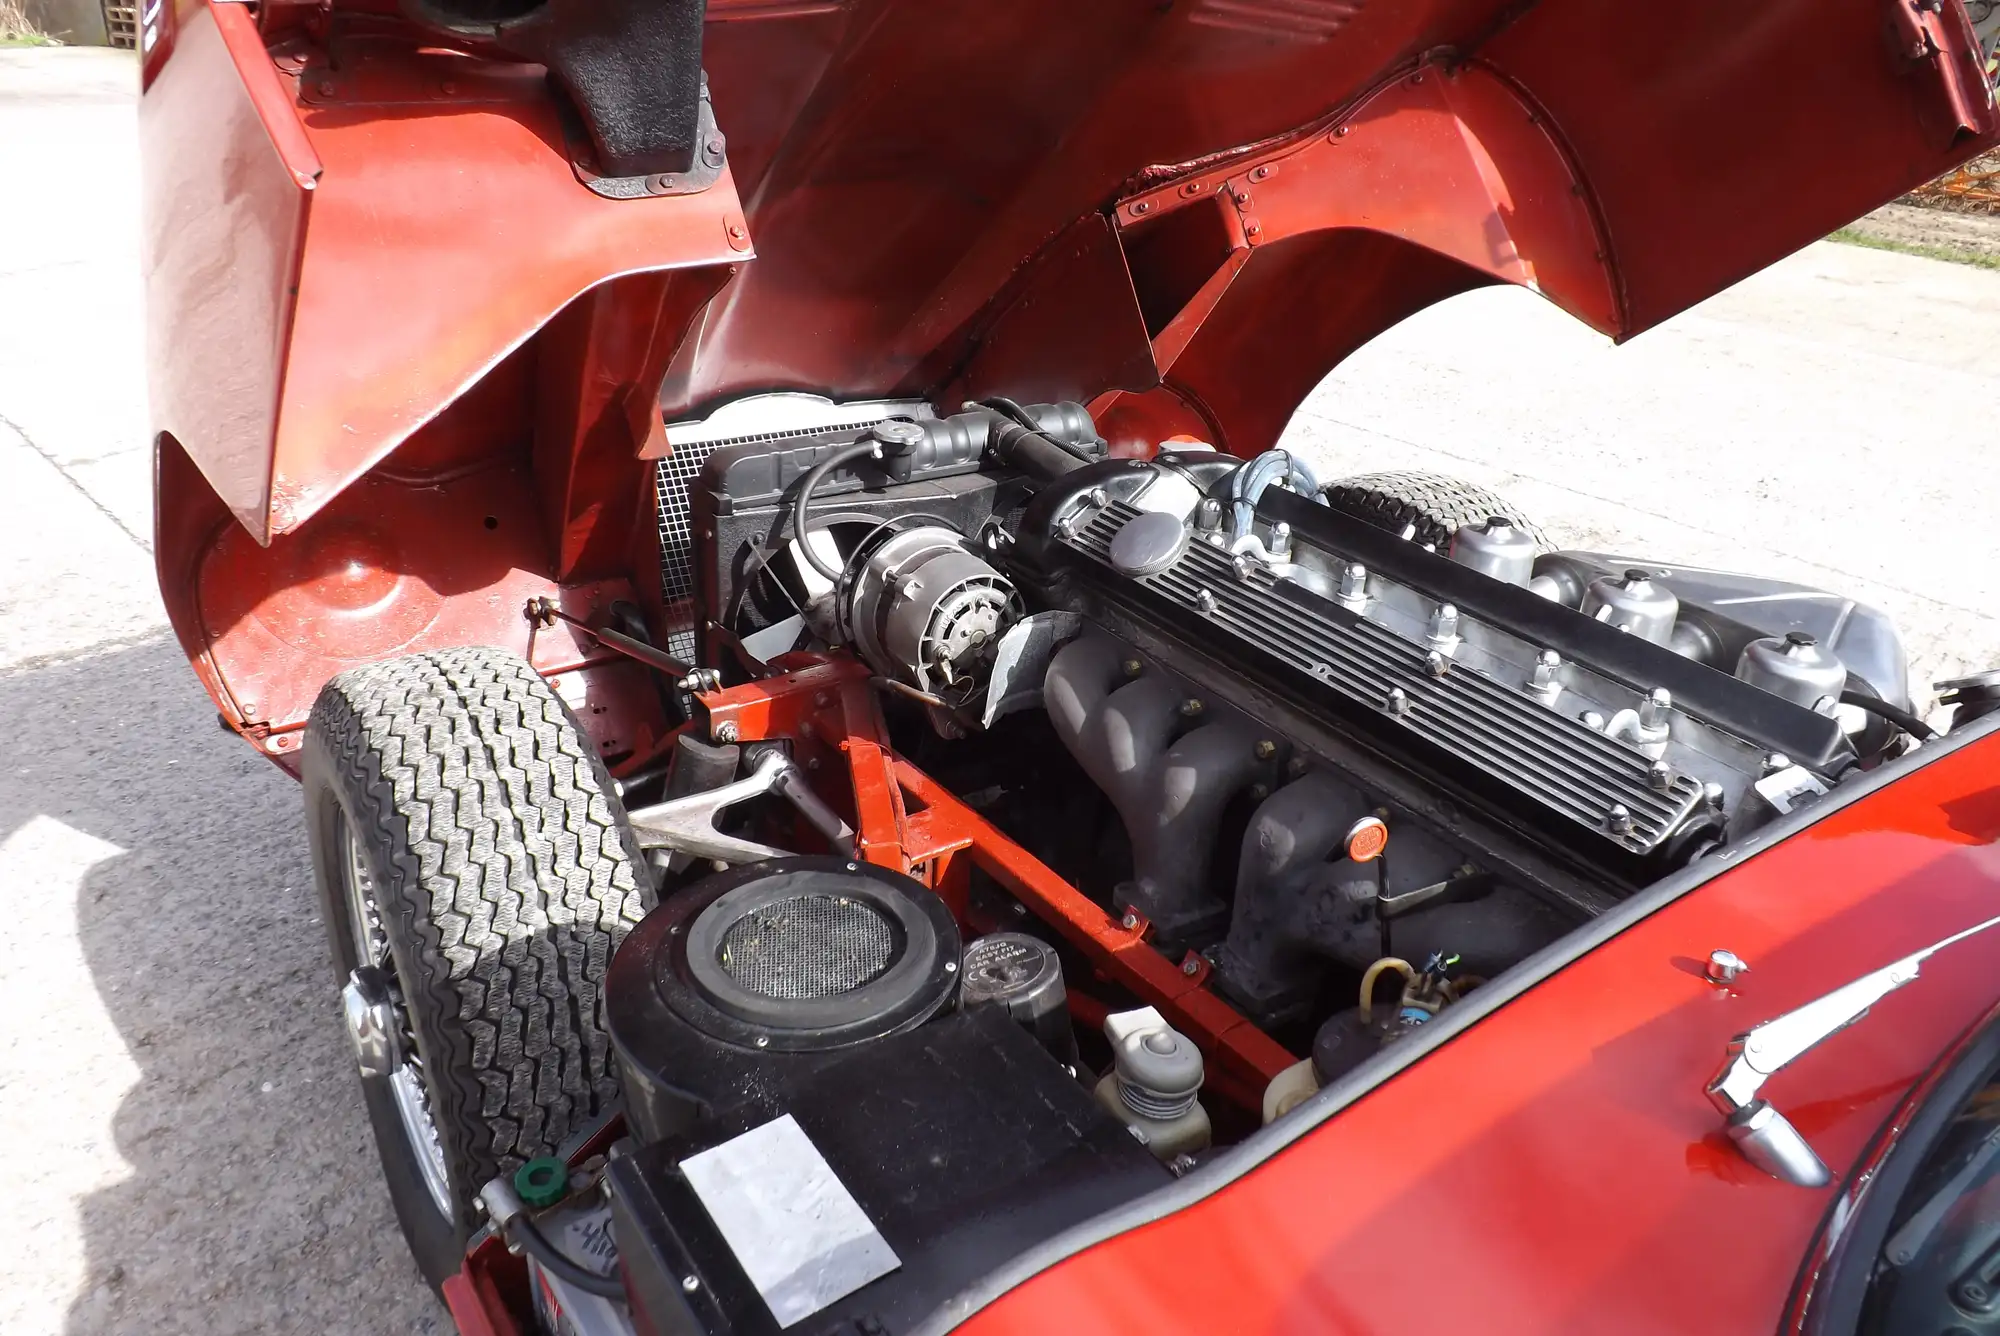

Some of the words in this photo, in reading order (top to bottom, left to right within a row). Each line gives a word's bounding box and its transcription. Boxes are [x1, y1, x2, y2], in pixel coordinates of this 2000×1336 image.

[970, 960, 990, 969] CAR
[995, 948, 1027, 961] ALARM
[976, 950, 999, 961] EASY
[1001, 945, 1015, 953] FIT
